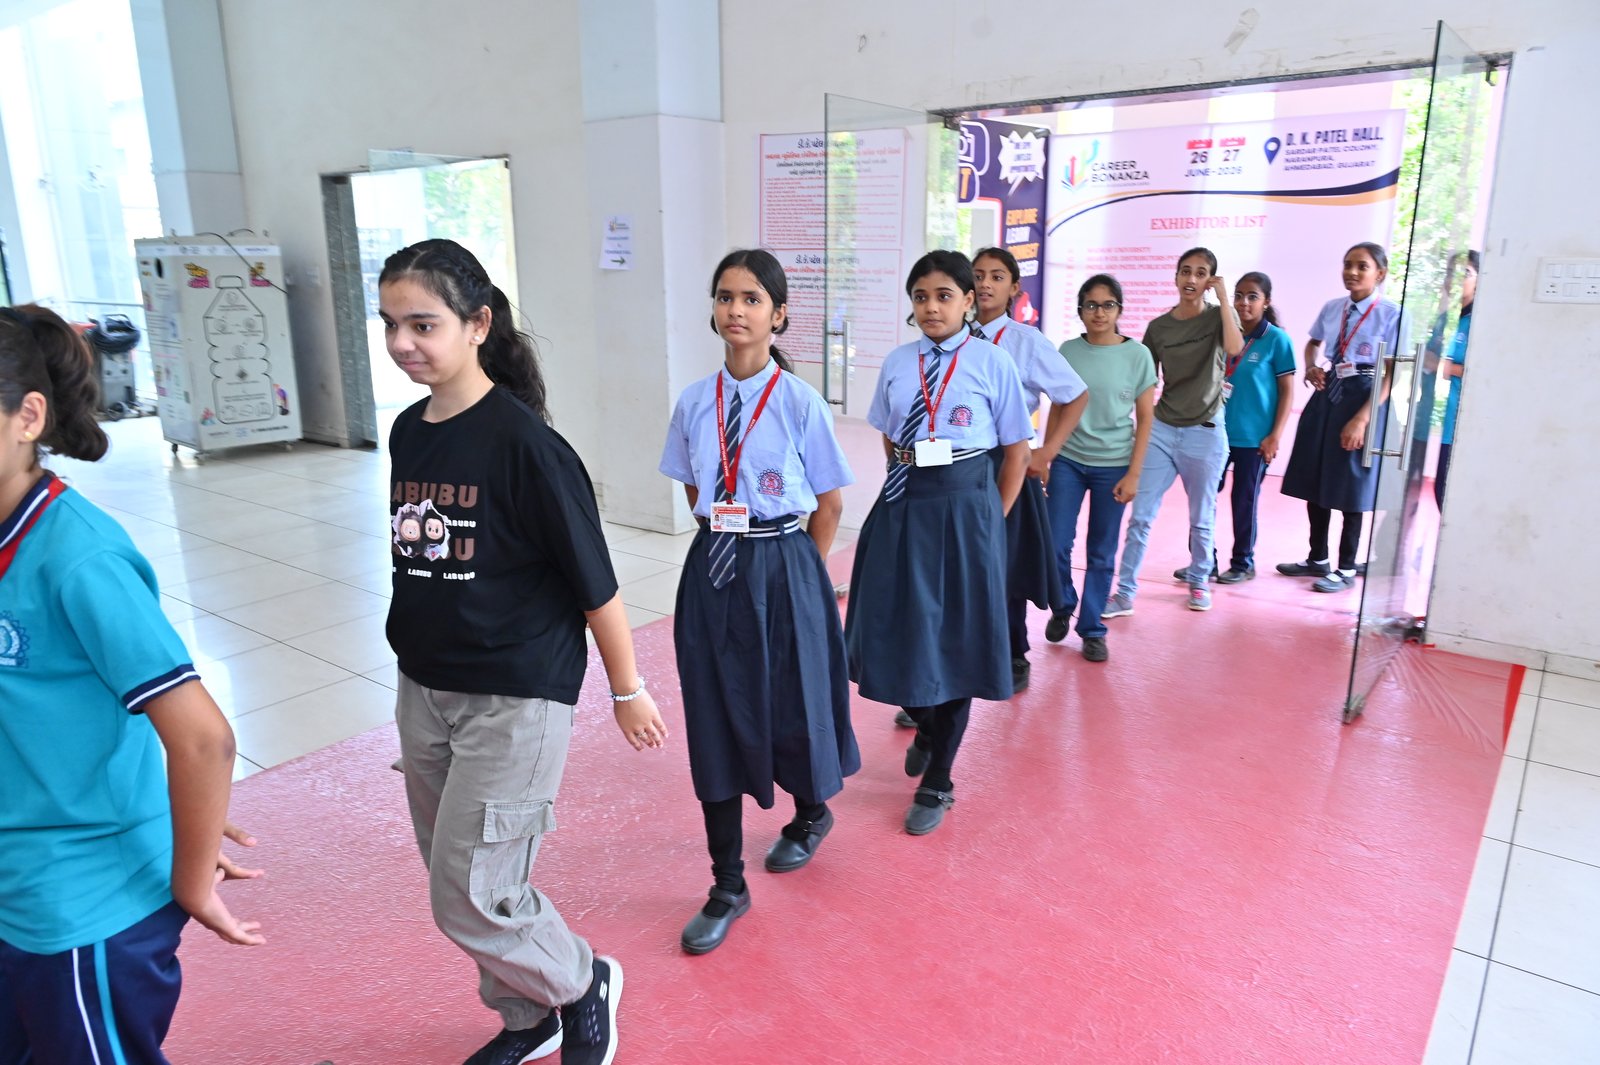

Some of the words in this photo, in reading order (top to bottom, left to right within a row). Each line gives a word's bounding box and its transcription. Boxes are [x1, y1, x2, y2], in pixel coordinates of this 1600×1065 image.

[1315, 129, 1348, 145] PATEL
[1190, 151, 1208, 164] 26
[1223, 149, 1240, 162] 27
[1284, 147, 1316, 156] SARDAR
[1317, 146, 1341, 154] PATEL
[1092, 160, 1137, 172] CAREER
[1336, 160, 1376, 169] GUJARAT
[1091, 171, 1150, 183] BONANZA
[1151, 216, 1230, 230] EXHIBITOR
[1234, 215, 1268, 228] LIST
[391, 481, 478, 509] ABUBU
[446, 519, 477, 528] ABUBU
[442, 571, 476, 581] LABUBU
